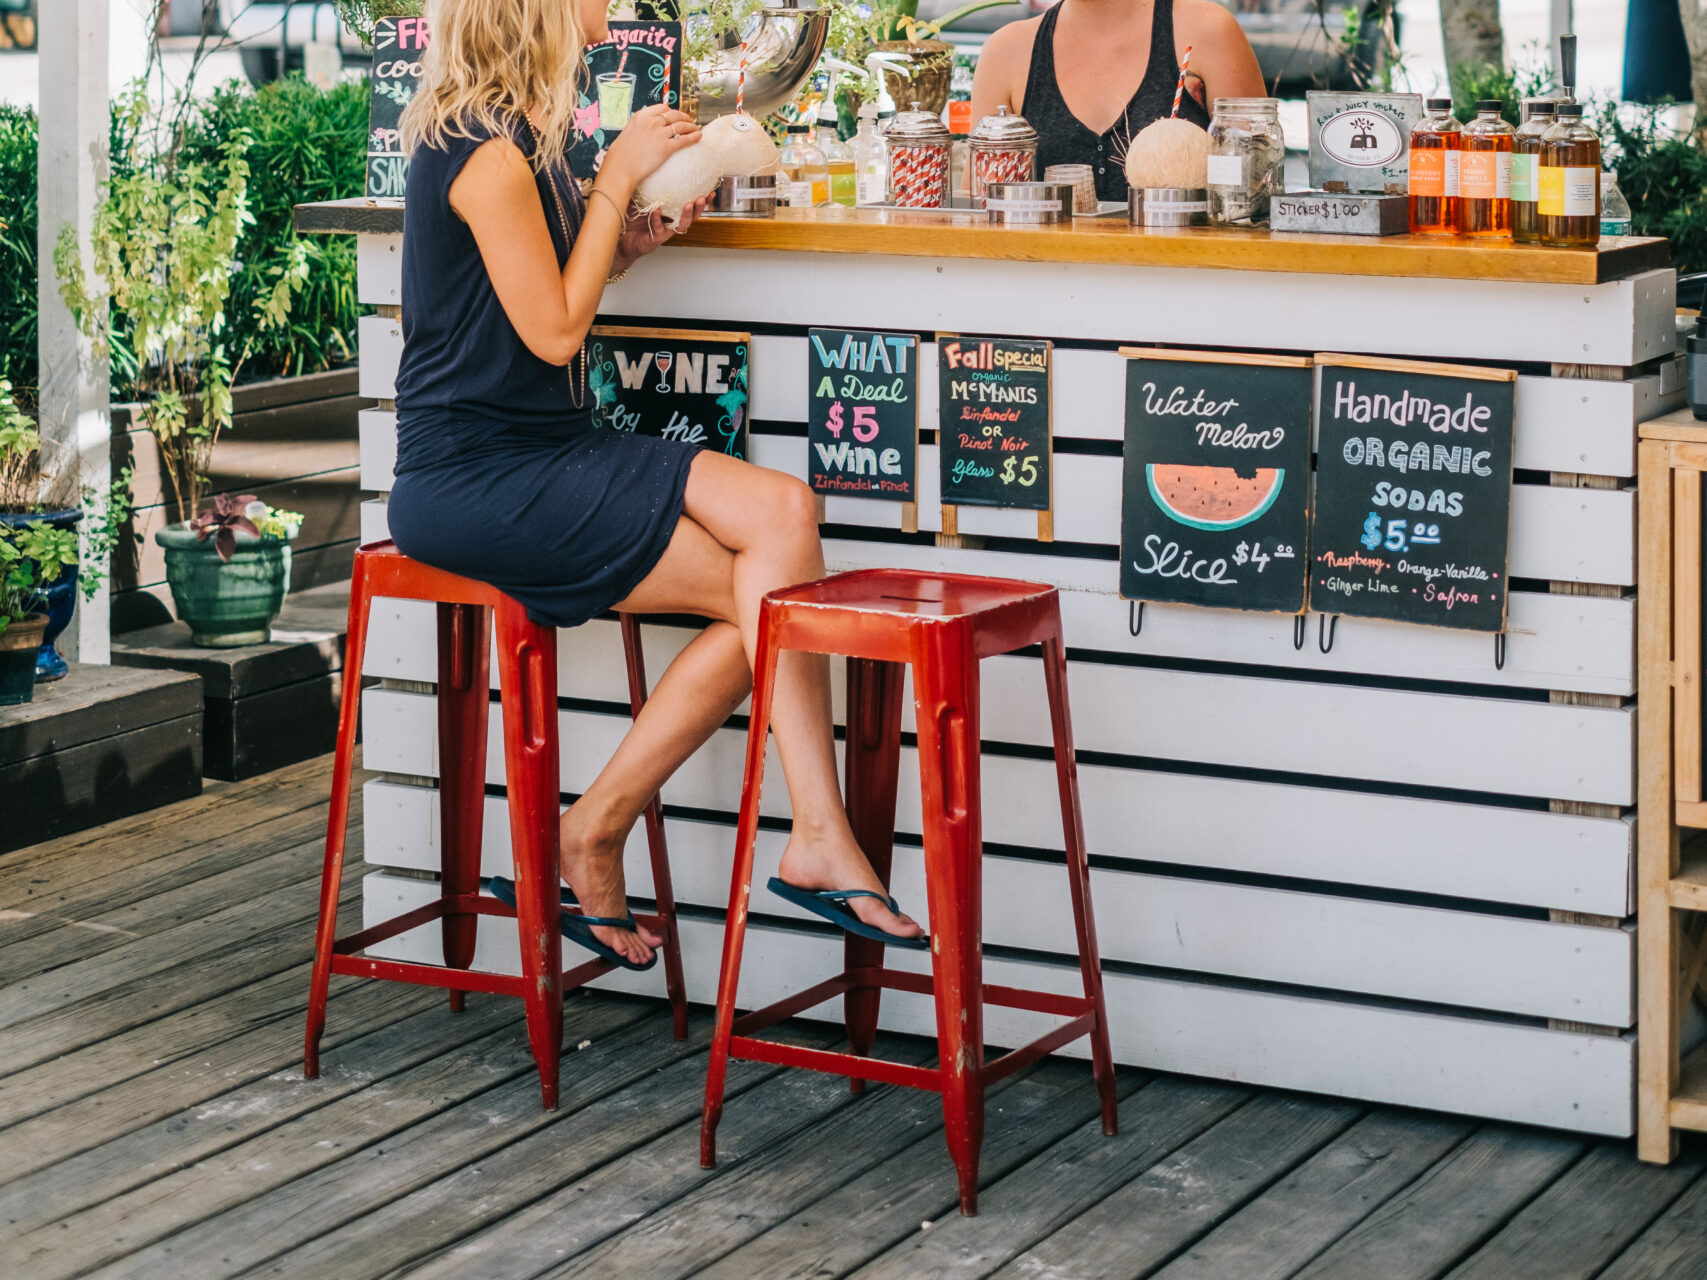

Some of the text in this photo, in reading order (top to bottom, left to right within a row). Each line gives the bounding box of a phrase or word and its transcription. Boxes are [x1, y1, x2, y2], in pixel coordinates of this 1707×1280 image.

[587, 26, 677, 53] argarita
[810, 333, 915, 374] WHAT
[944, 342, 994, 370] Fall
[816, 375, 908, 403] A Deal
[1142, 382, 1240, 417] Water
[960, 406, 1021, 424] Zinfandel
[1334, 381, 1492, 433] Handmade
[661, 410, 708, 443] the
[958, 433, 1030, 451] Pinot Noir
[982, 426, 1003, 437] OR
[999, 455, 1039, 487] $5
[1343, 437, 1493, 477] ORGANIC
[814, 474, 871, 490] Zinfandel
[880, 480, 910, 493] Pinot
[1371, 481, 1464, 517] SODAS
[1133, 534, 1238, 584] Slice
[1323, 550, 1385, 574] Raspberry
[1326, 577, 1479, 610] Ginger Lime Safron
